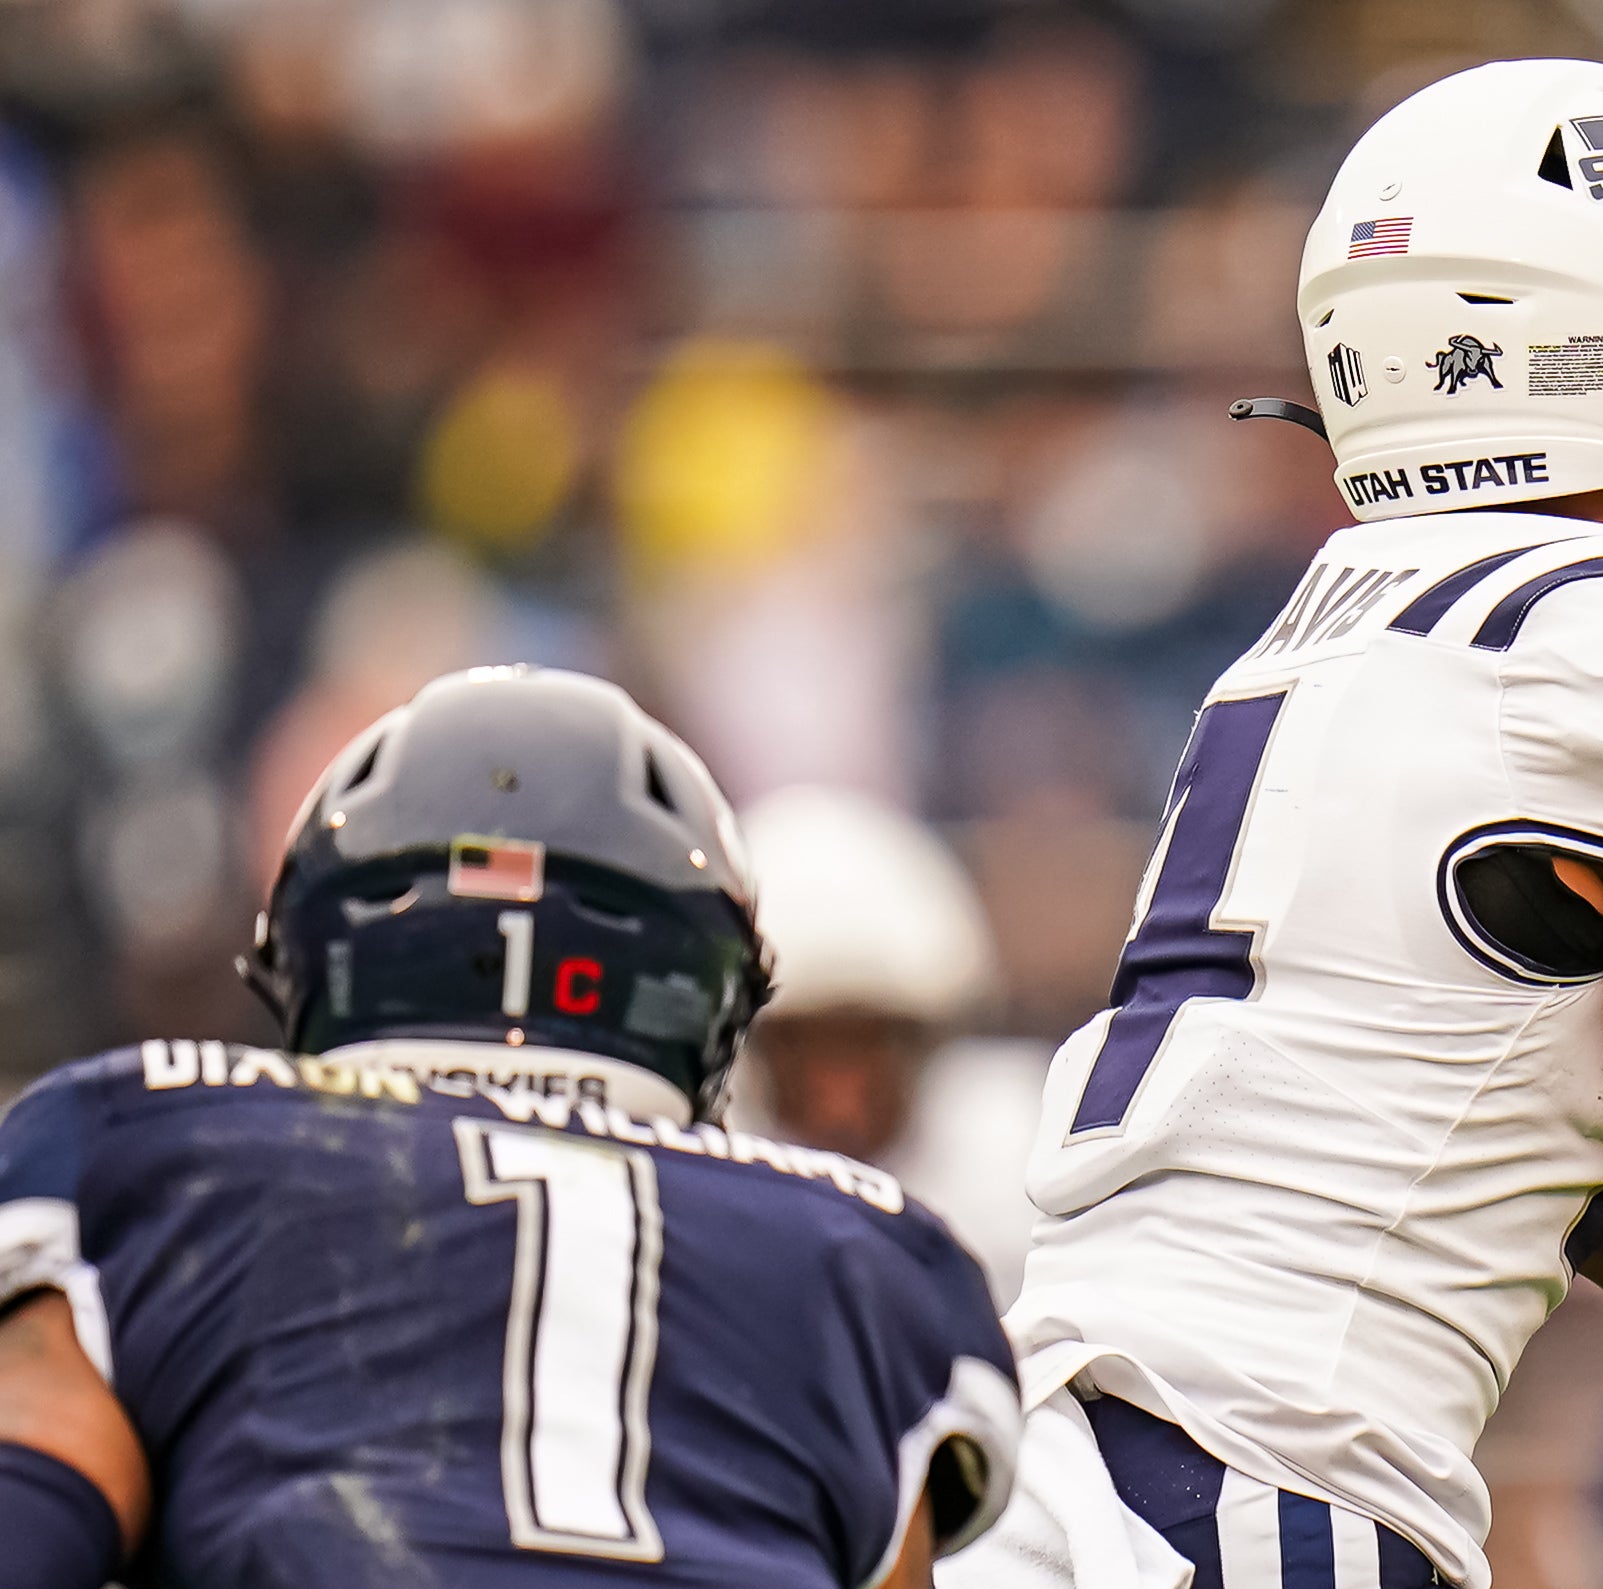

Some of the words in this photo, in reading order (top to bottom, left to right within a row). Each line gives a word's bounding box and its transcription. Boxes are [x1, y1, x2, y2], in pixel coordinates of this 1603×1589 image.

[1343, 468, 1414, 507] UTAH
[1420, 452, 1550, 495] STATE
[1243, 563, 1420, 663] AVIS
[497, 910, 534, 1018] 1
[555, 957, 602, 1015] C
[452, 1117, 666, 1563] 1
